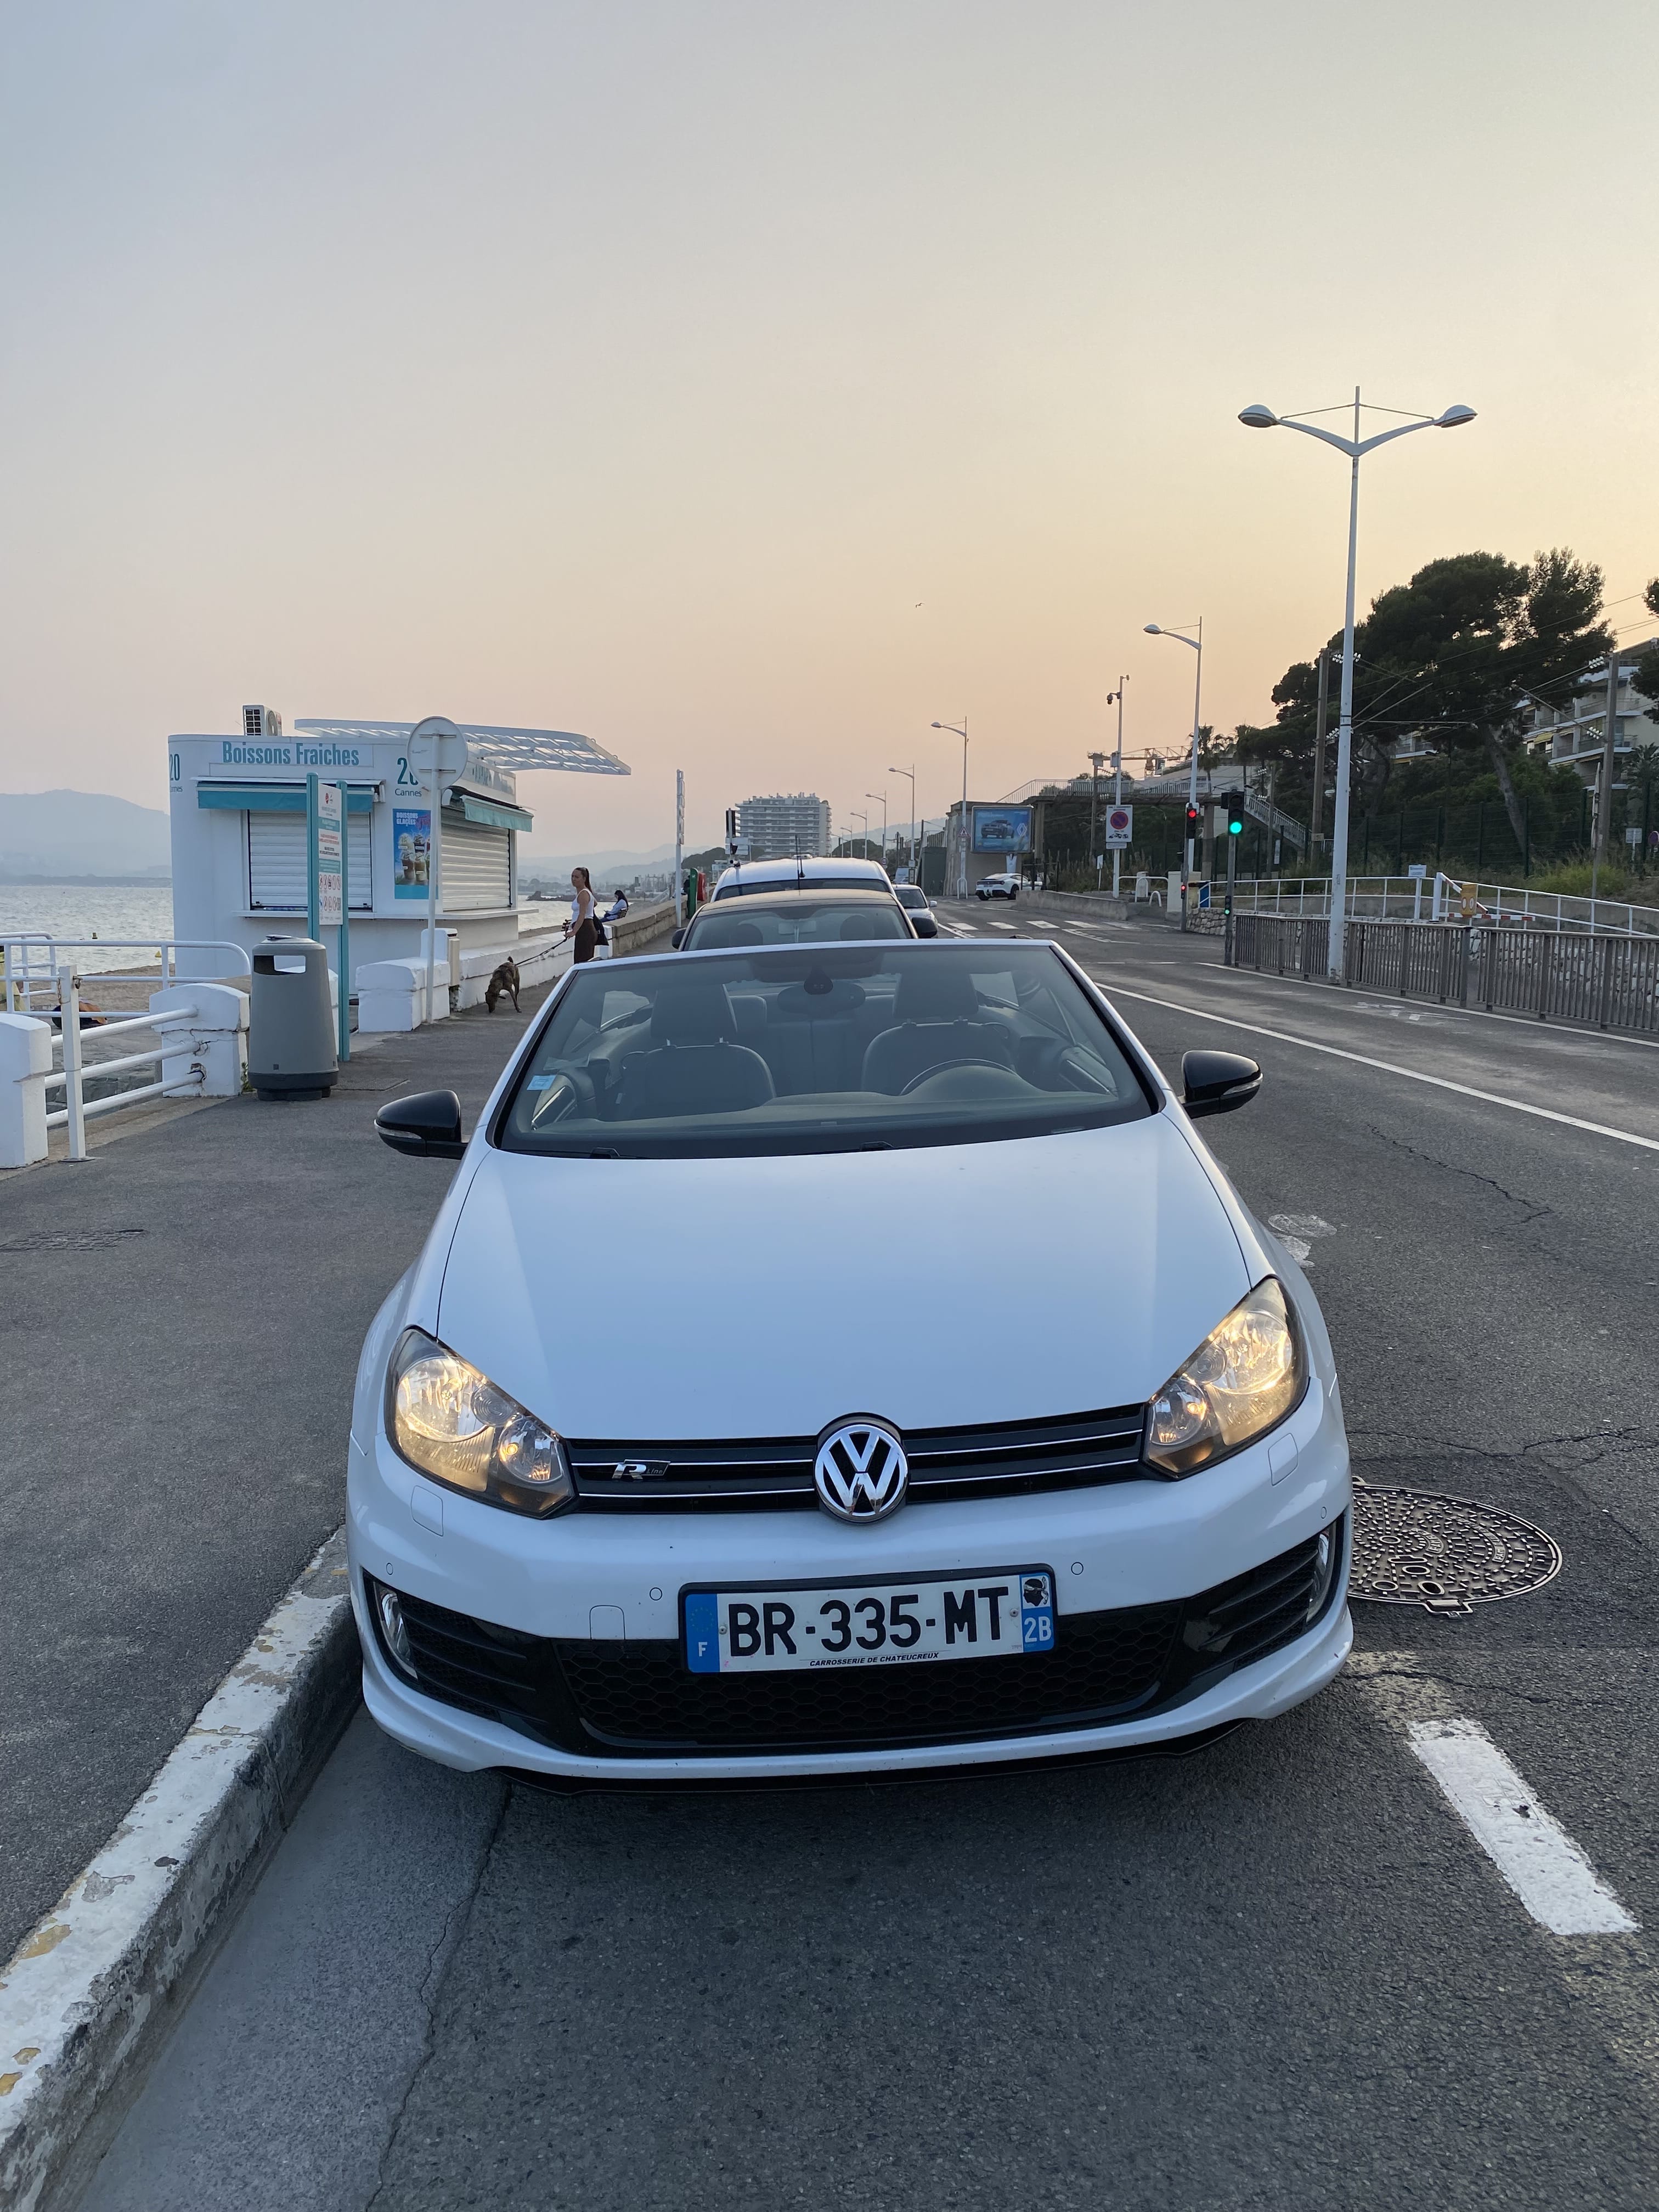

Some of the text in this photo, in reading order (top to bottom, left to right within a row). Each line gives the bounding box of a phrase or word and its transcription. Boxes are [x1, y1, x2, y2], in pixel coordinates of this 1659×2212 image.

[223, 741, 359, 765] Boissons Fraiches
[394, 788, 422, 797] Cannes
[612, 1463, 647, 1480] R
[727, 1586, 1009, 1657] BR-335-MT
[1024, 1616, 1052, 1643] 2B
[698, 1641, 707, 1657] F
[810, 1657, 865, 1667] CARROSSERIE
[879, 1652, 939, 1662] CHATEUCREUX
